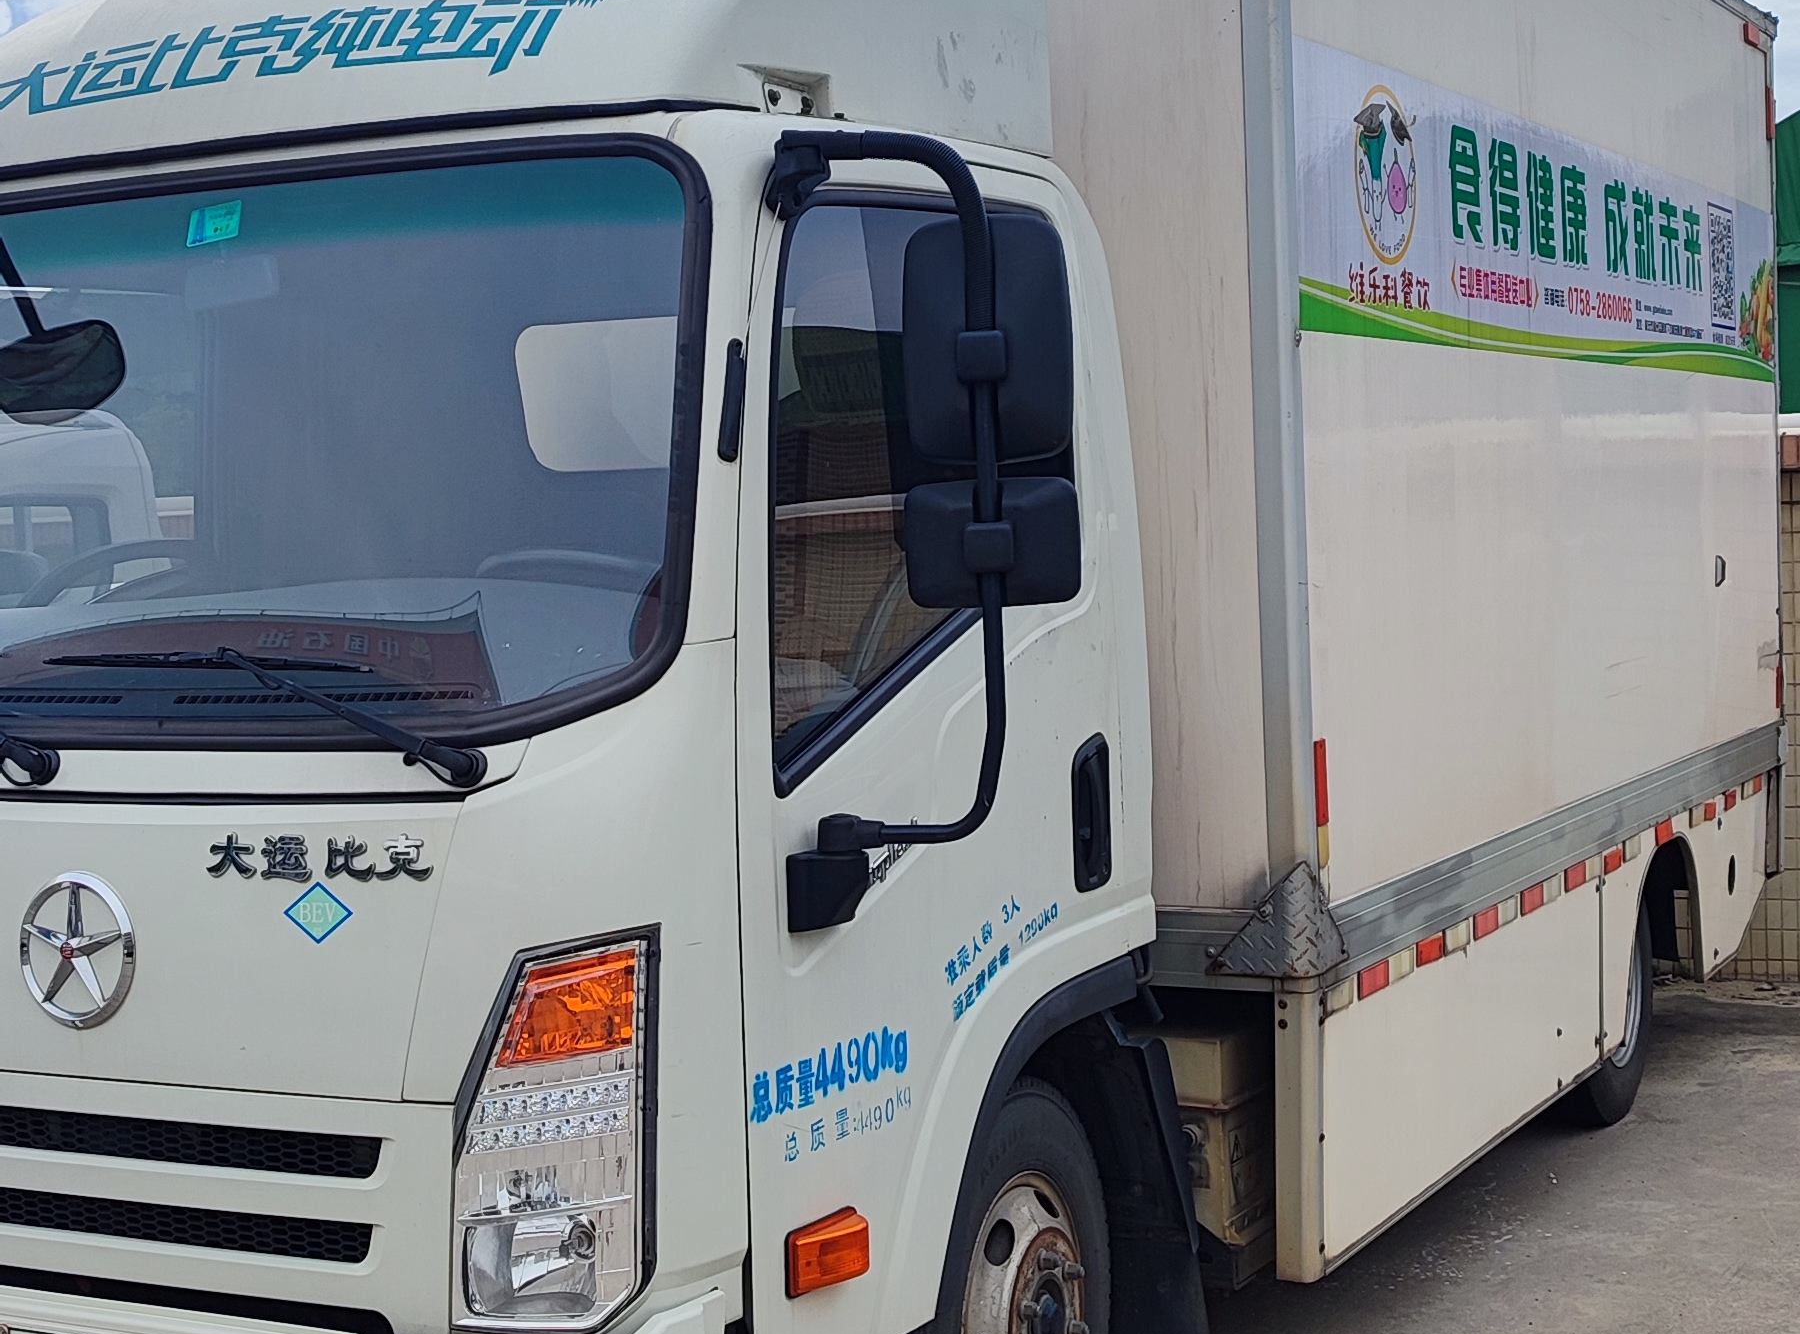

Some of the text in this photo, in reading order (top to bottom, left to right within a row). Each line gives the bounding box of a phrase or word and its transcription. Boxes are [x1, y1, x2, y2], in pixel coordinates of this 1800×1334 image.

[1449, 123, 1704, 294] 食得健康 成就未来
[1378, 239, 1392, 255] LOVE
[1393, 233, 1406, 253] FOOD
[1348, 261, 1431, 311] 维乐科餐饮
[1568, 285, 1633, 324] 0758-2860066
[299, 902, 336, 923] BEV
[945, 894, 1021, 986] 准乘人数 3人
[750, 1025, 908, 1124] 总质量4490kg
